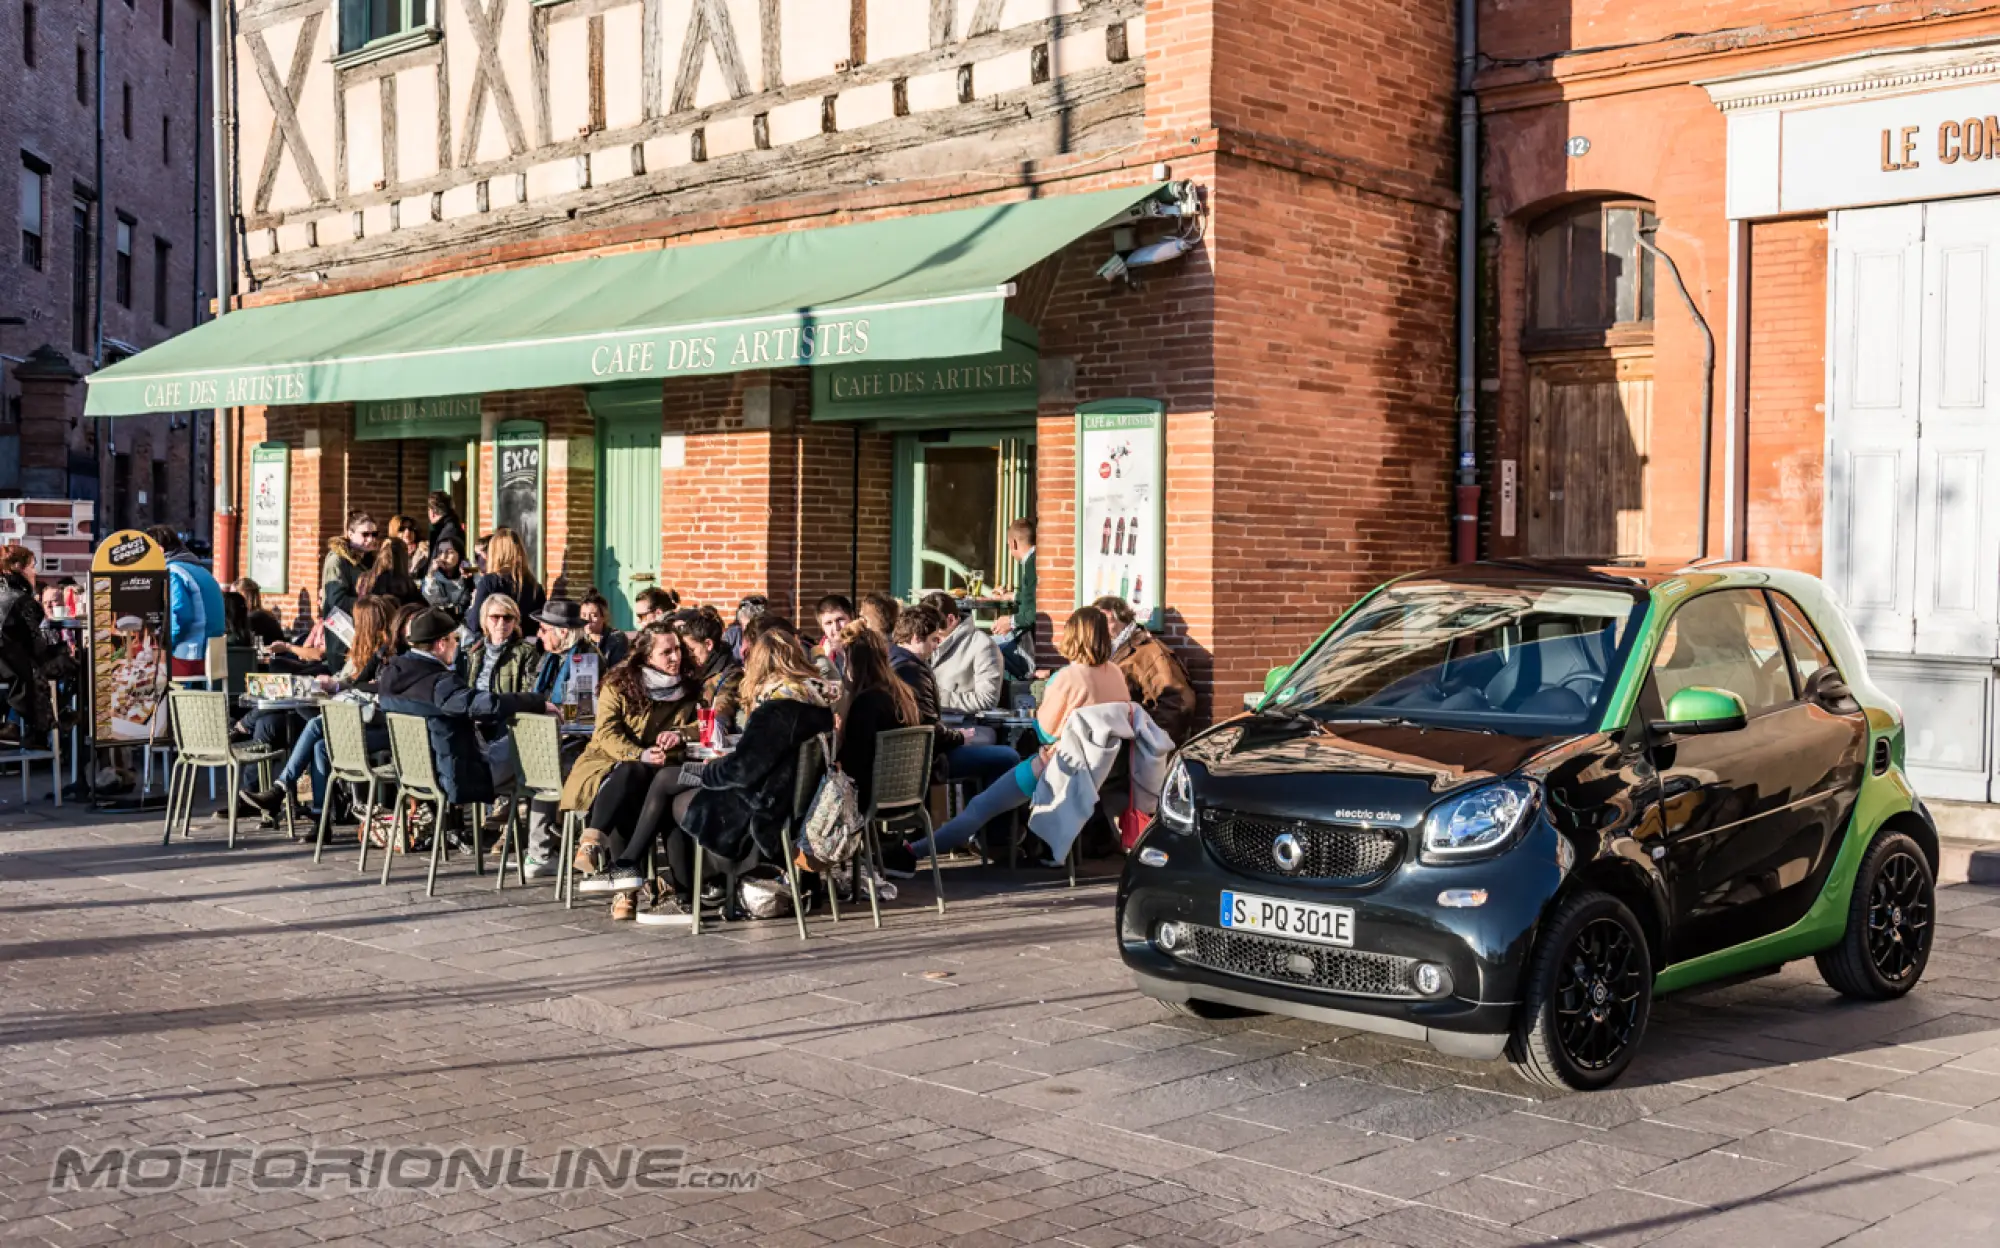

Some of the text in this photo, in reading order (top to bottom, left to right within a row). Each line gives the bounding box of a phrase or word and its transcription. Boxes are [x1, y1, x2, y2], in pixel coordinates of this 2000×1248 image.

[1568, 137, 1585, 155] 12
[1881, 125, 1920, 172] LE
[590, 319, 870, 376] CAFE DES ARTISTES
[144, 372, 305, 408] CAFE DES ARTISTES
[889, 371, 925, 394] DES
[931, 362, 1033, 391] ARTISTES
[403, 400, 427, 421] DES
[502, 447, 539, 473] EXPO
[1335, 808, 1401, 821] electric drive
[1234, 899, 1349, 940] S PQ 301E
